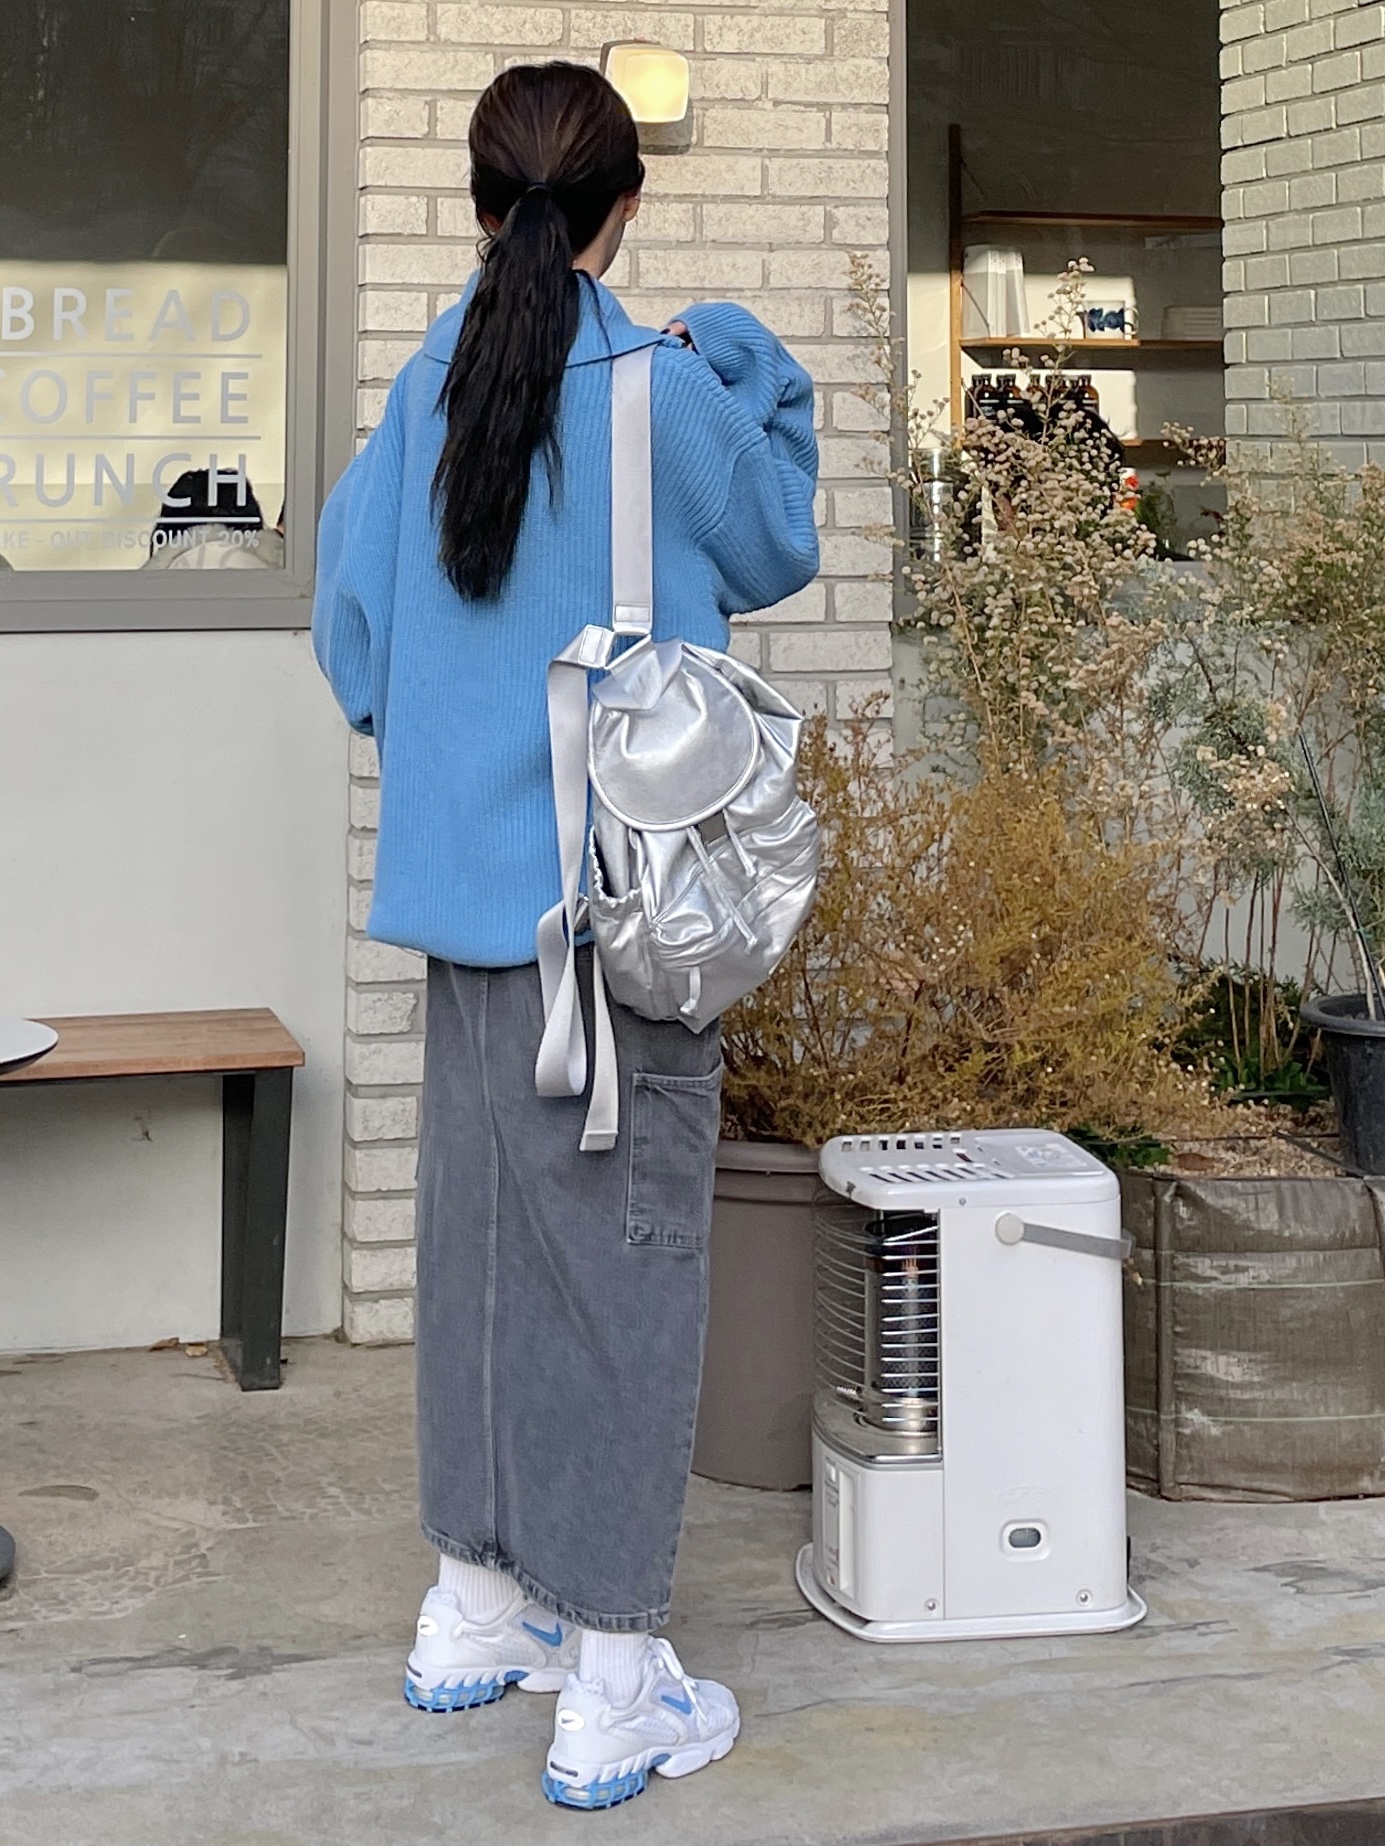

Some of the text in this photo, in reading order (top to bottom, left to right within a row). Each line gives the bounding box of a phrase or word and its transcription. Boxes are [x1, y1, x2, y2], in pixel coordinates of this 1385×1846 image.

[1, 287, 250, 342] BREAD
[0, 368, 249, 425] OFFEE
[102, 529, 209, 549] DISCOUNT
[219, 529, 259, 548] 20%
